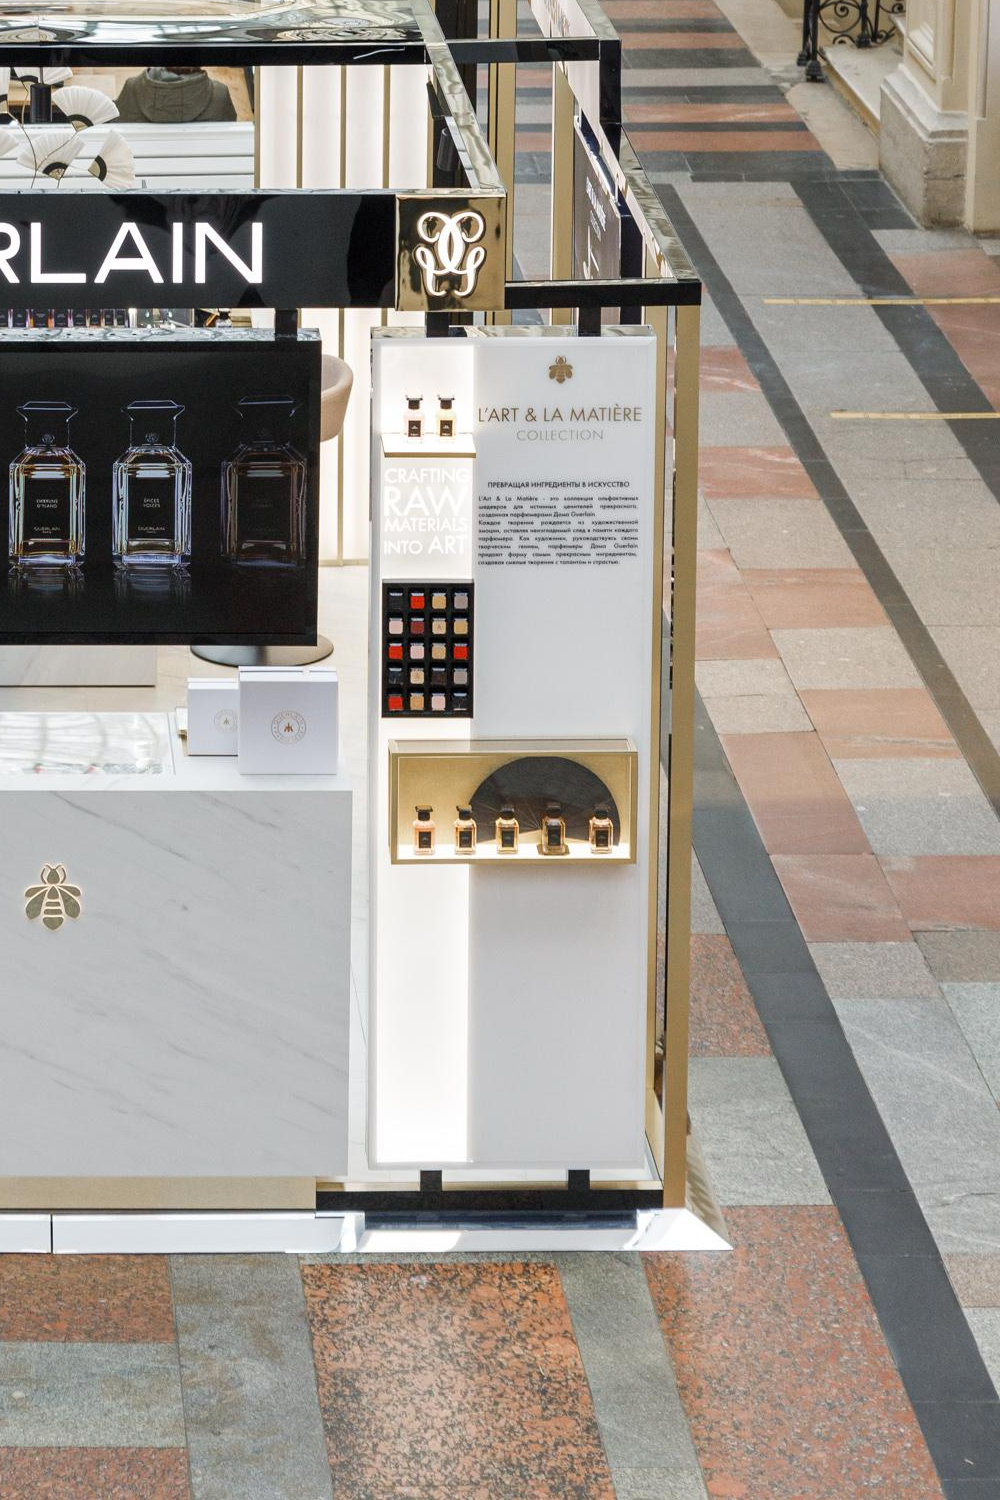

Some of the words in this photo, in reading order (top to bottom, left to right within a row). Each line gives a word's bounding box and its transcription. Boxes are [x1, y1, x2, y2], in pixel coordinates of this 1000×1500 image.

[478, 406, 519, 422] L'ART
[525, 407, 536, 422] &
[543, 407, 563, 422] LA
[570, 404, 642, 422] MATIÈRE
[516, 430, 604, 441] COLLECTION
[384, 467, 472, 484] CRAFTING
[488, 481, 529, 489] ПРЕВРАЩАЯ
[531, 481, 580, 489] ИНГРЕДИЕНТЫ
[384, 485, 469, 516] RAW
[384, 517, 468, 532] MATERIALS
[383, 540, 423, 555] INTO
[428, 534, 468, 555] ART
